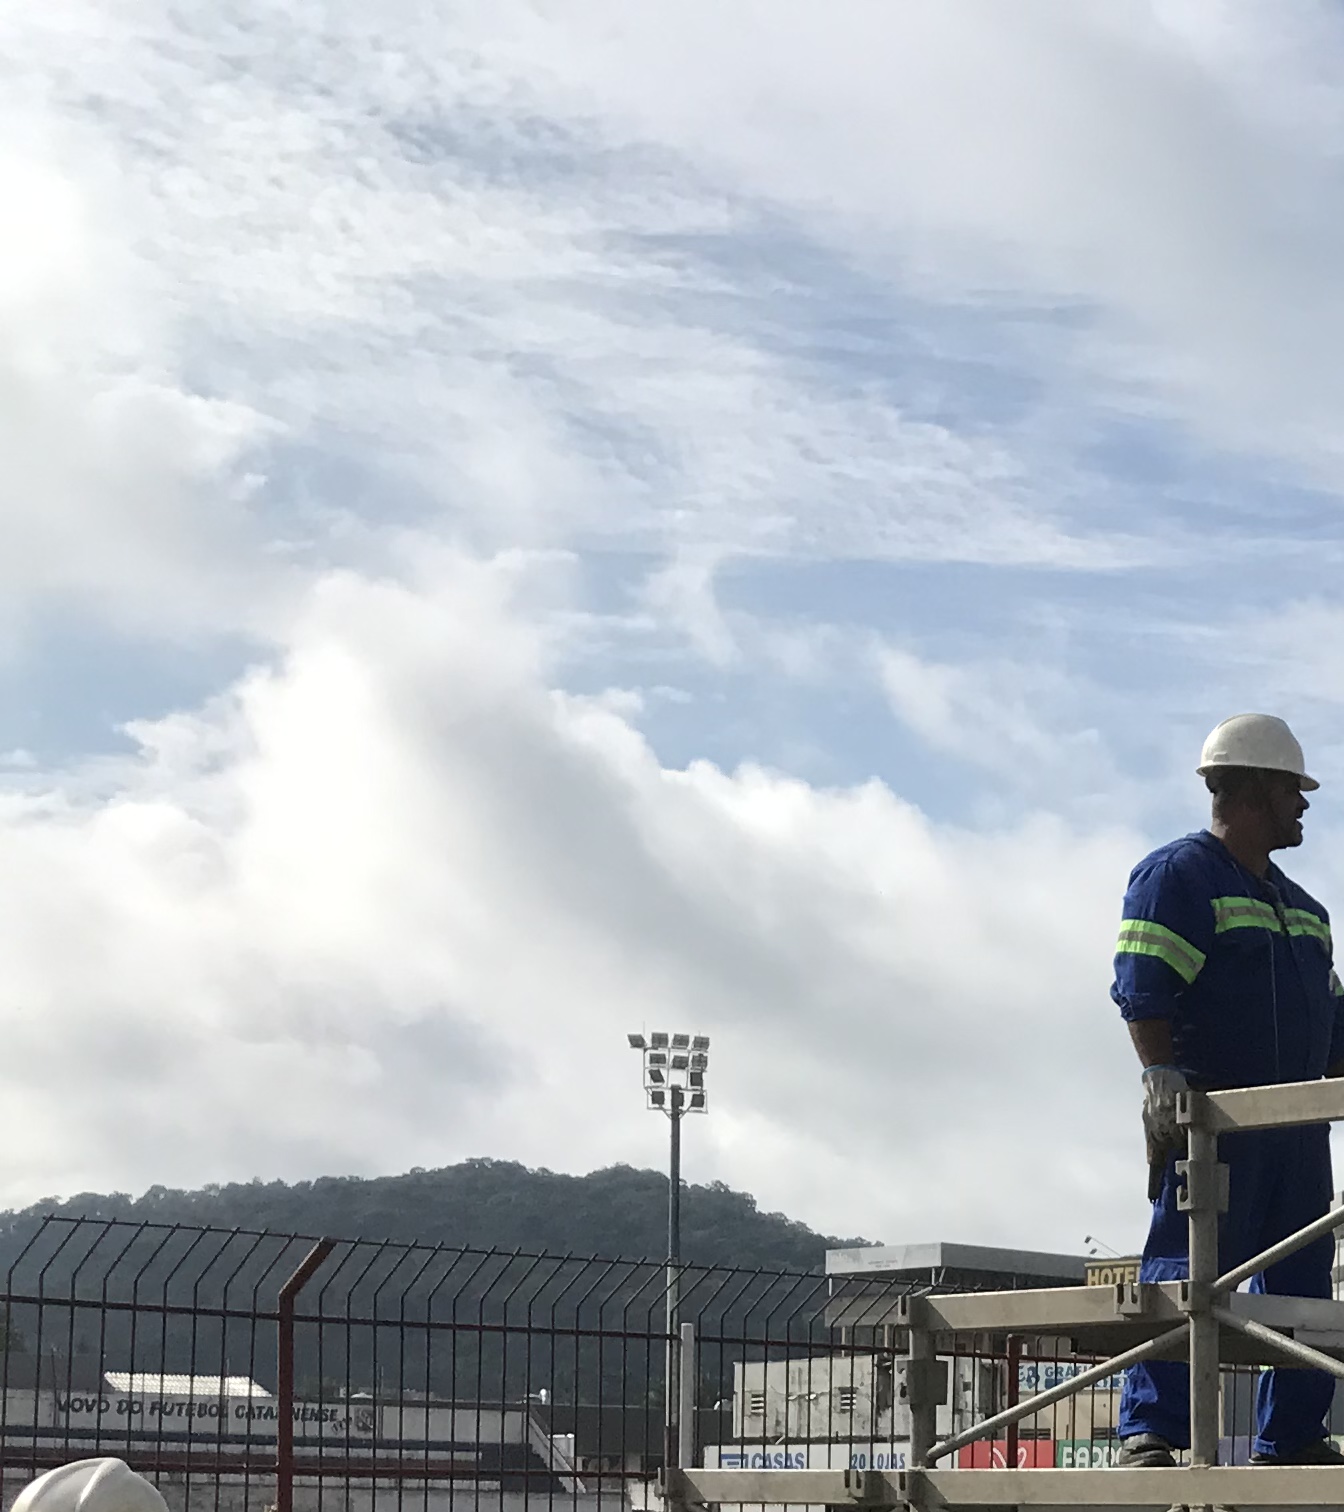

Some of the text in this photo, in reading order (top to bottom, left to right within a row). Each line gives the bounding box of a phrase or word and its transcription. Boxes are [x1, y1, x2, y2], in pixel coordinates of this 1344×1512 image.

[234, 1404, 339, 1423] CATANENSE
[751, 1452, 805, 1469] CASAS
[851, 1453, 906, 1469] 20 OJAS
